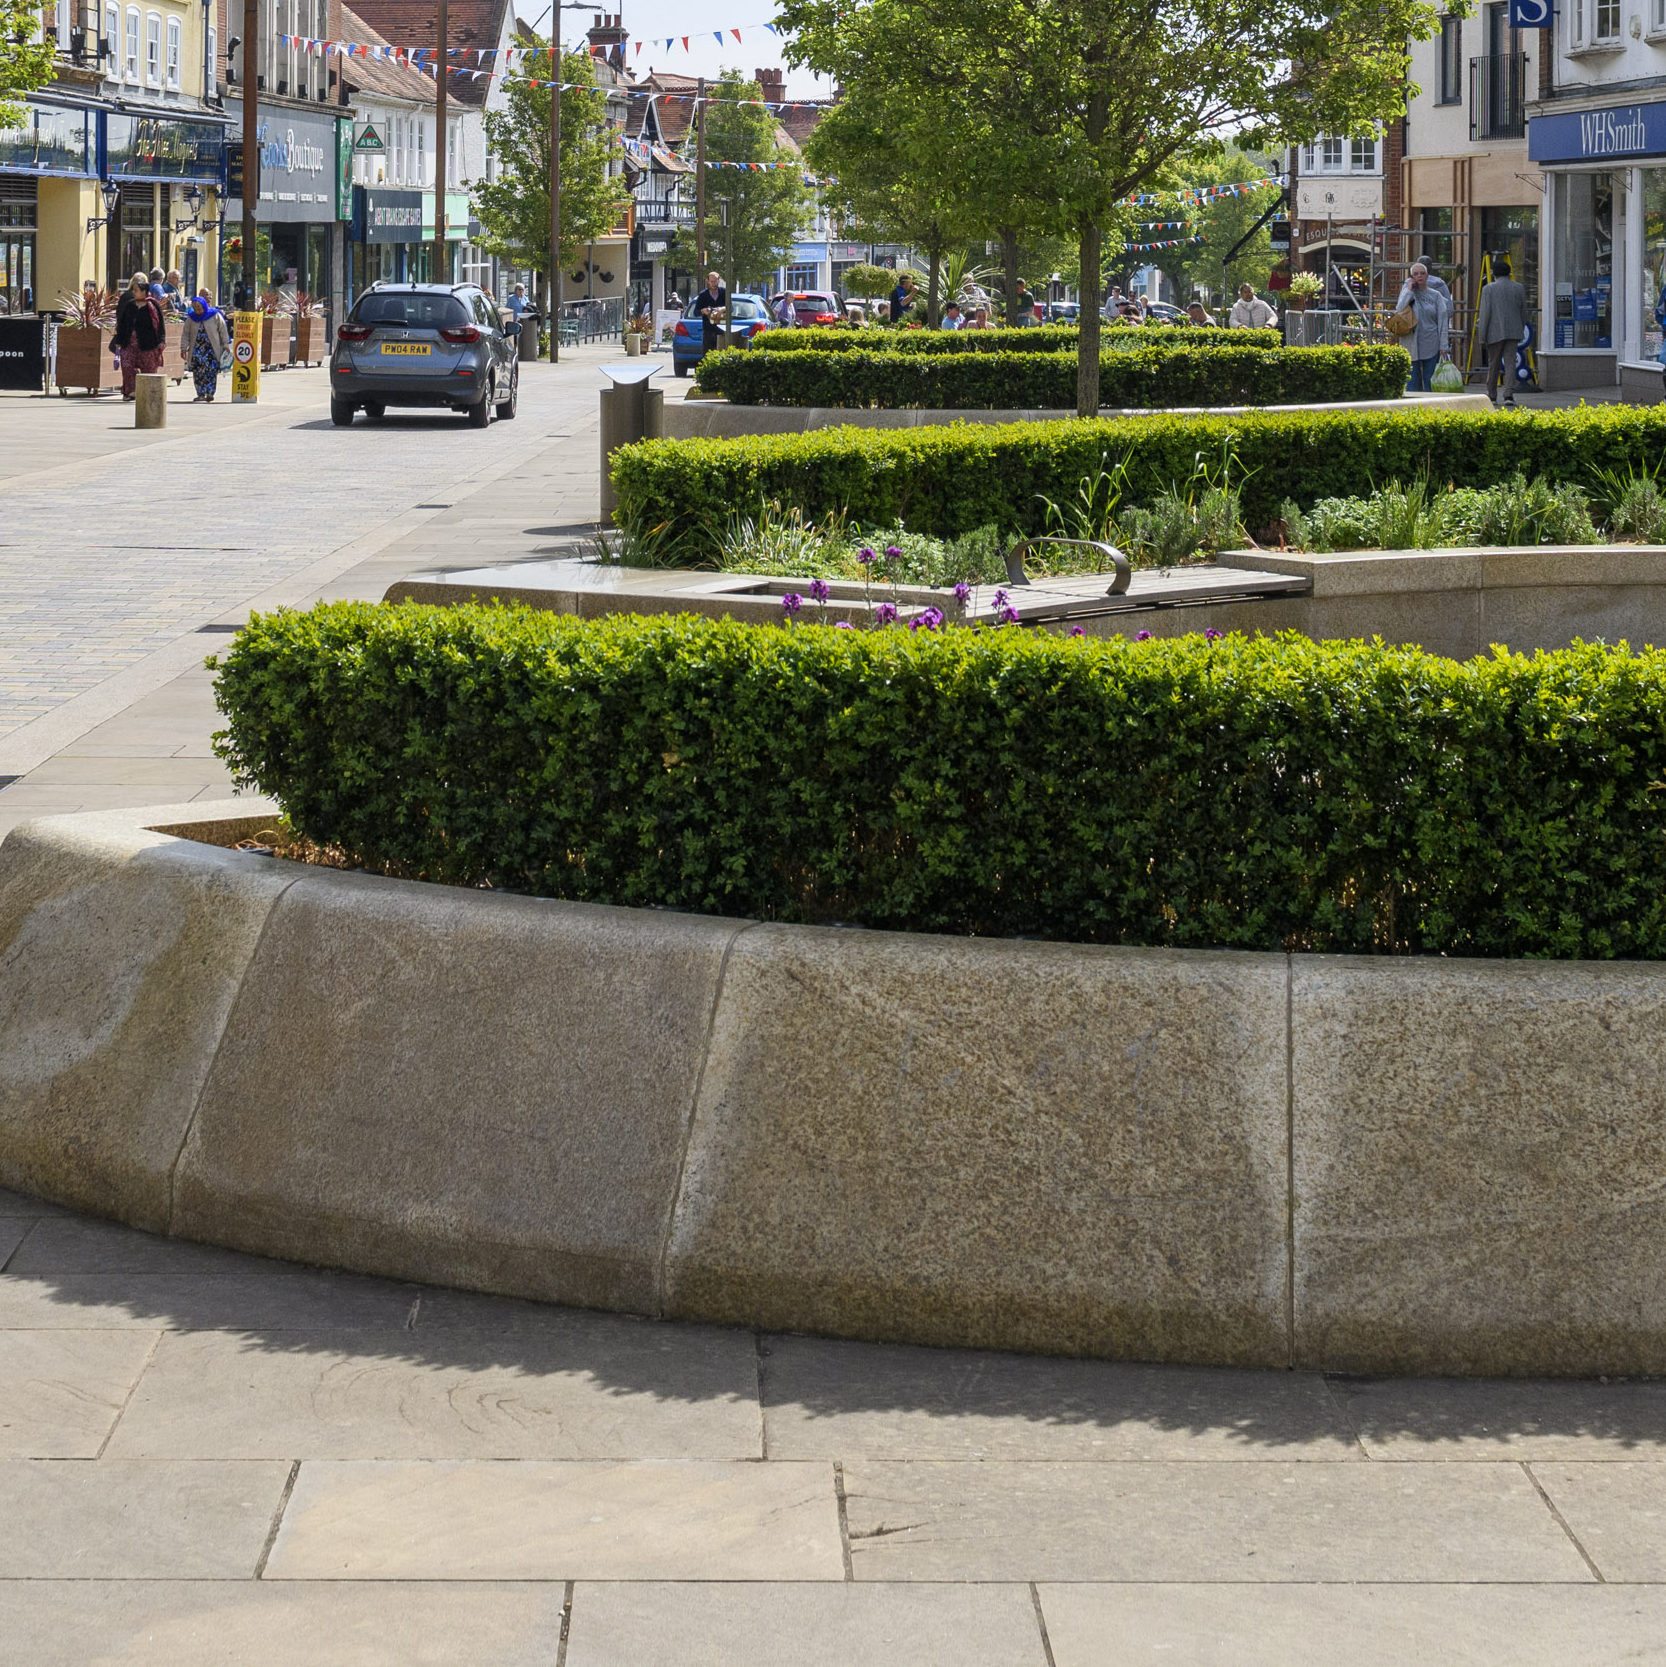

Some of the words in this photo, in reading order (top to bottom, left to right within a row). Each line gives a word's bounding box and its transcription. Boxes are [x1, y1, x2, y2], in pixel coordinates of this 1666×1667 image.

[1580, 107, 1646, 155] WHSmith
[287, 128, 324, 178] Boutique
[238, 346, 251, 356] 20
[410, 345, 428, 354] RAW
